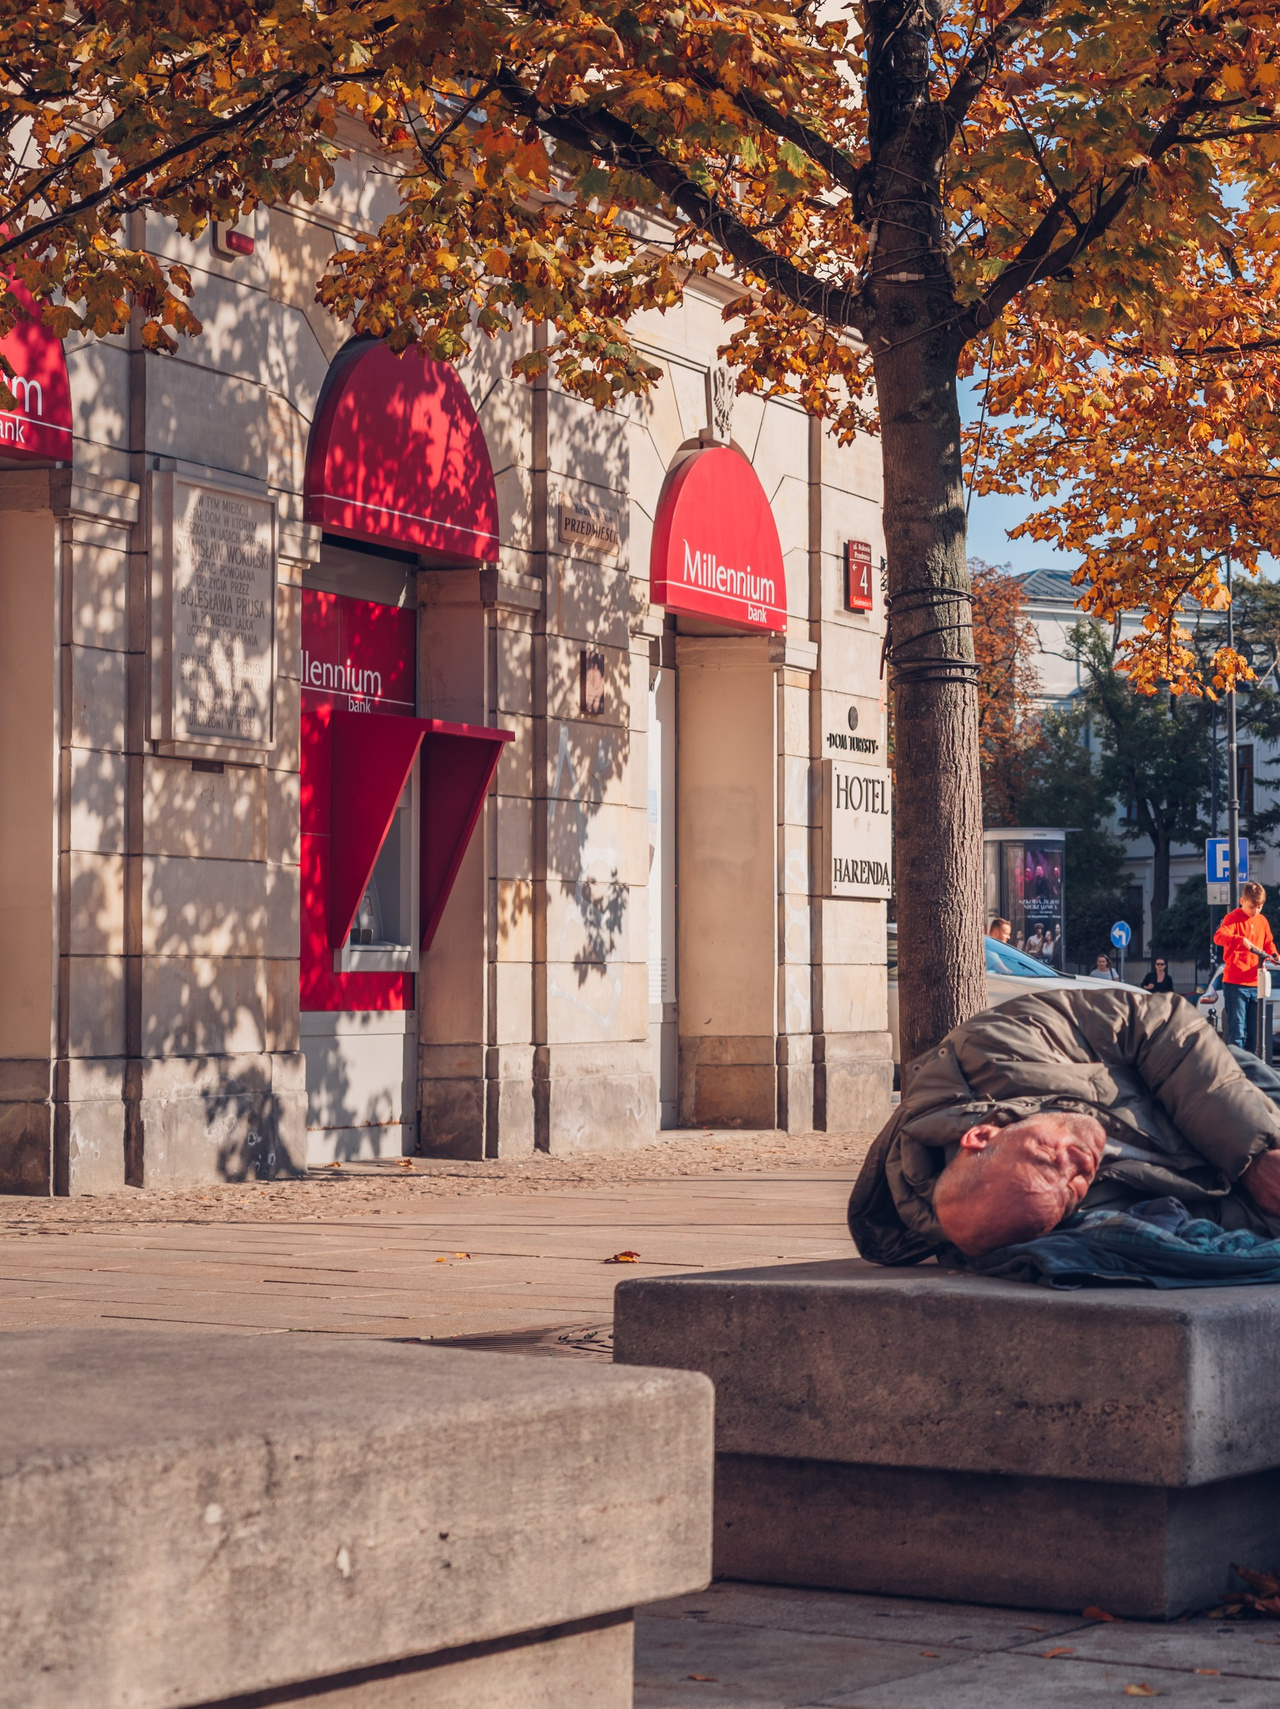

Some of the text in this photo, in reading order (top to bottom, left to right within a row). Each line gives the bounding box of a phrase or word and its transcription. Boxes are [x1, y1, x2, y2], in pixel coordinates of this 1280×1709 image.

[0, 417, 25, 443] ank
[206, 496, 220, 511] TYM
[210, 526, 217, 539] W
[224, 514, 230, 528] W
[226, 544, 269, 571] WOKULSKI
[219, 564, 256, 583] POWOŁANA
[682, 538, 775, 604] Millennium
[860, 565, 868, 595] 4
[196, 573, 206, 588] DO
[231, 580, 250, 596] PRZEZ
[181, 586, 265, 619] BOLESŁAWA PRUSA
[747, 602, 767, 624] bank
[192, 609, 198, 622] W
[301, 649, 382, 695] llennium
[348, 695, 371, 713] bank
[828, 732, 877, 754] DOM TURYSTY
[836, 773, 889, 815] HOTEL
[833, 857, 890, 886] HARENDA
[1216, 843, 1240, 878] P
